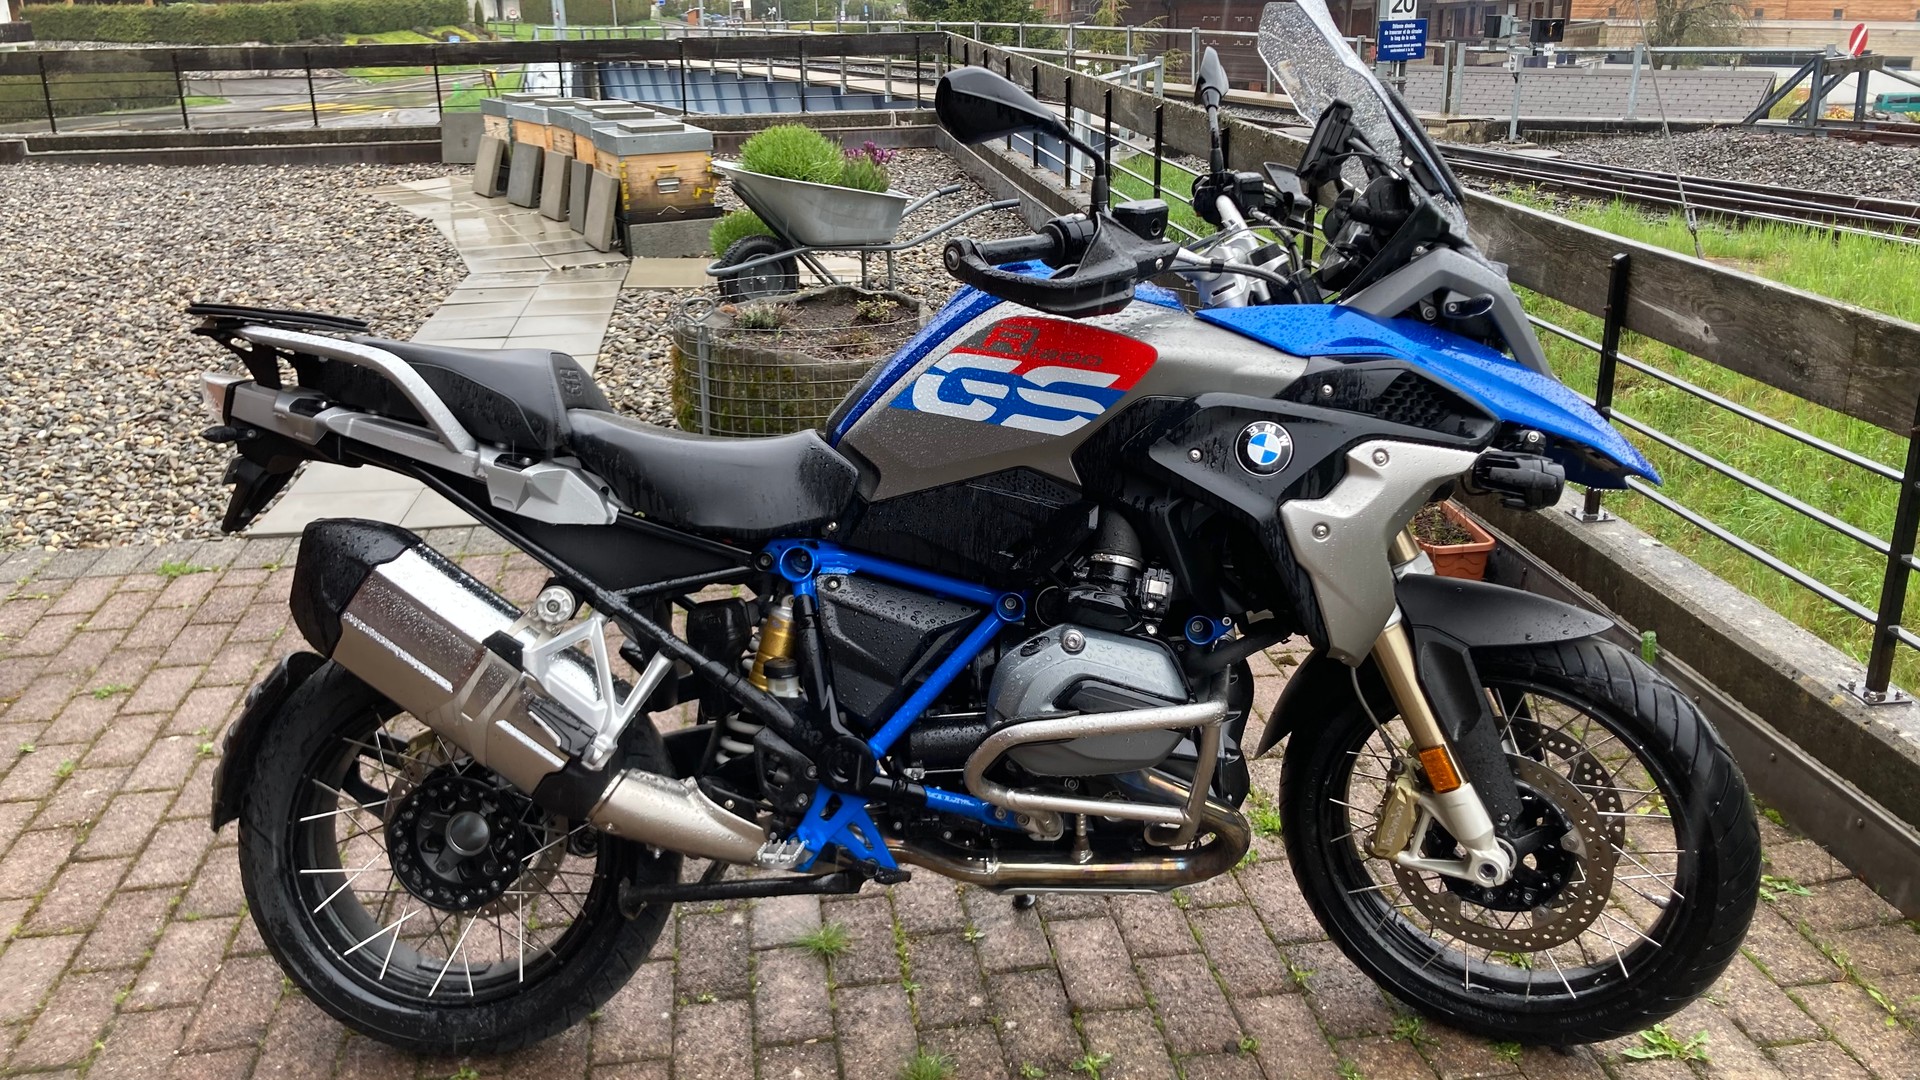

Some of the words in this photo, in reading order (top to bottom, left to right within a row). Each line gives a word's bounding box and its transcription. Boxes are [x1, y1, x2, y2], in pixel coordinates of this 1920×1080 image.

[1391, 0, 1415, 13] 20
[912, 352, 1121, 437] GS
[1246, 423, 1290, 447] BMW
